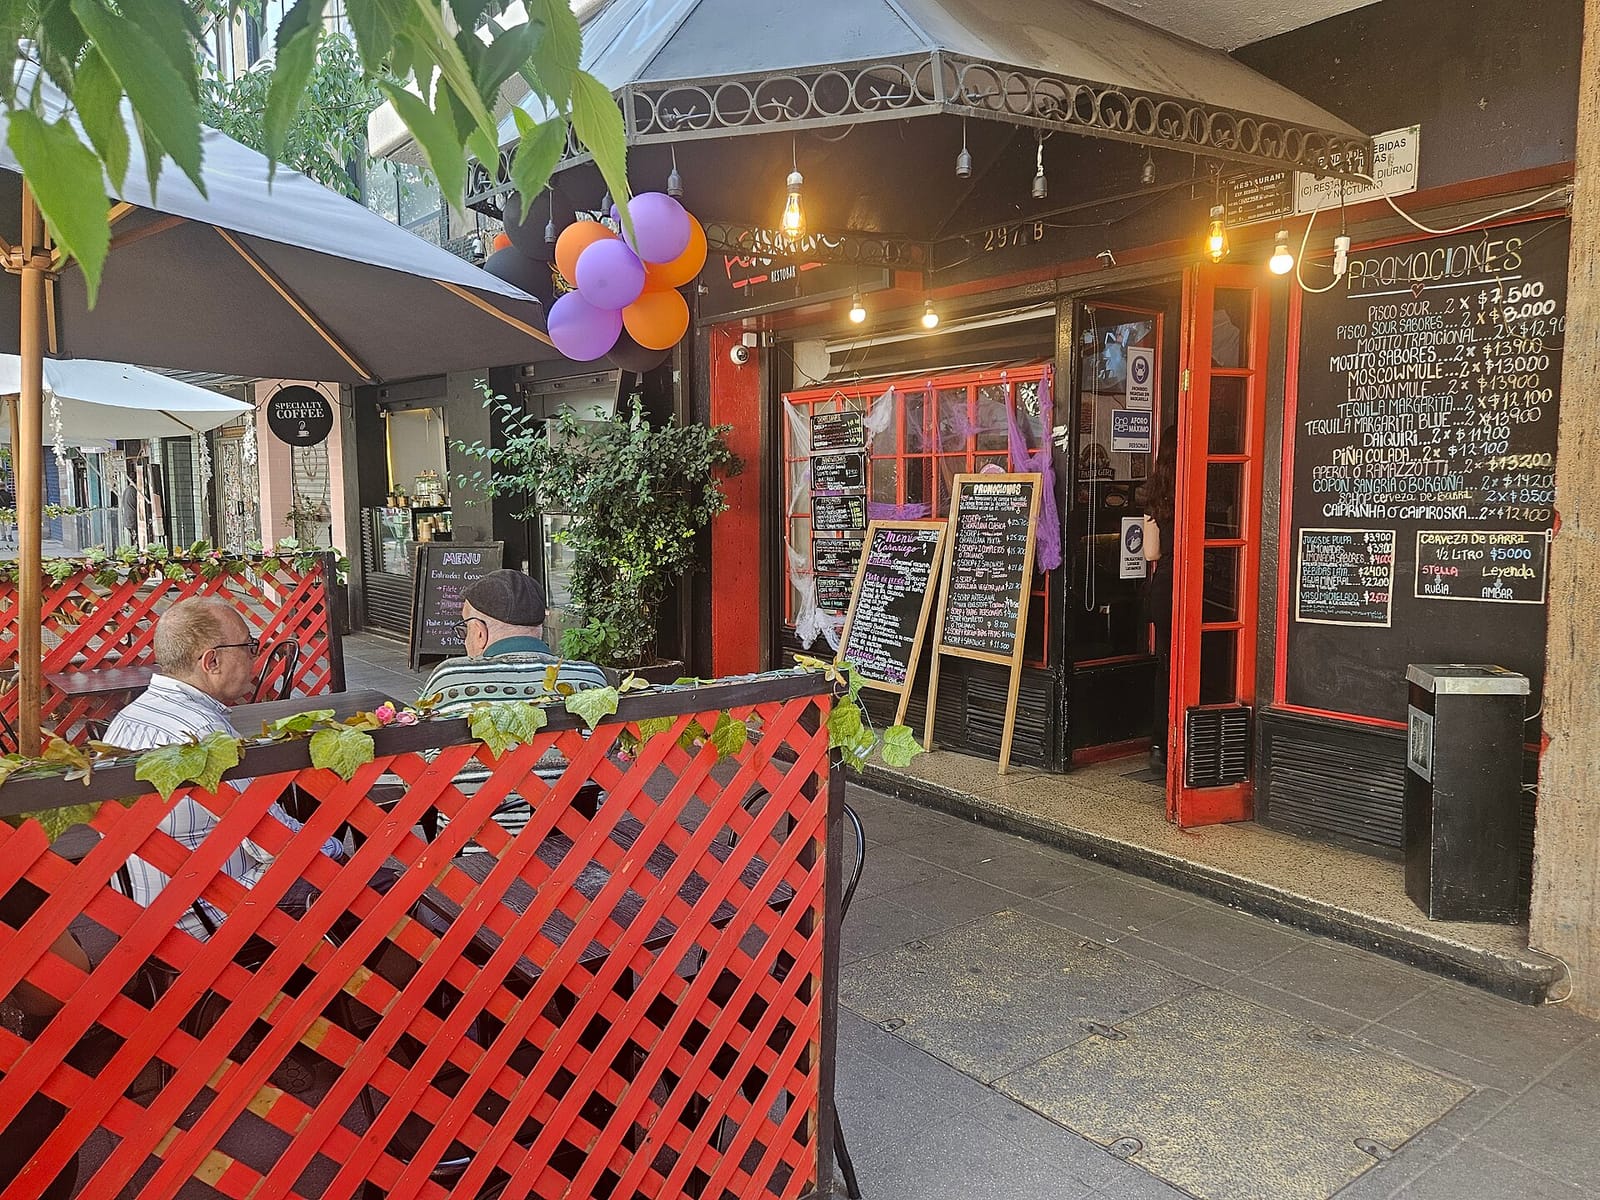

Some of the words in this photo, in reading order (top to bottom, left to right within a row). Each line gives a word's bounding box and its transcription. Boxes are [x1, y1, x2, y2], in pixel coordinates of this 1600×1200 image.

[1373, 138, 1407, 154] EBIDAS
[1377, 163, 1413, 179] DIURNO
[1300, 187, 1312, 198] (C)
[1326, 190, 1333, 200] Y
[1034, 220, 1043, 240] B
[1347, 238, 1523, 289] PROMOCIONES
[771, 265, 796, 283] RESTOBAR
[1371, 320, 1397, 336] SOUR
[1461, 312, 1471, 328] 2
[1519, 315, 1566, 338] $12.90
[1347, 383, 1395, 402] LONDON
[1448, 379, 1459, 395] 2
[275, 401, 322, 410] SPECIALTY
[1337, 399, 1386, 419] TEQUILA
[276, 408, 325, 420] COFFEE
[1130, 416, 1148, 425] AFORO
[1304, 417, 1351, 436] TEQUILA
[1354, 413, 1414, 434] MARGARITA
[1312, 465, 1351, 480] APEROL
[1312, 478, 1350, 493] COPON
[1480, 475, 1490, 491] 2
[1338, 492, 1371, 505] SCHOP
[1306, 544, 1345, 554] LIMONADAS
[1435, 546, 1448, 560] 1/2
[1489, 547, 1532, 562] $5000
[442, 552, 481, 566] MENU
[1482, 563, 1536, 579] Leyenda
[1300, 591, 1318, 600] VASO
[1481, 586, 1513, 599] AMBAR
